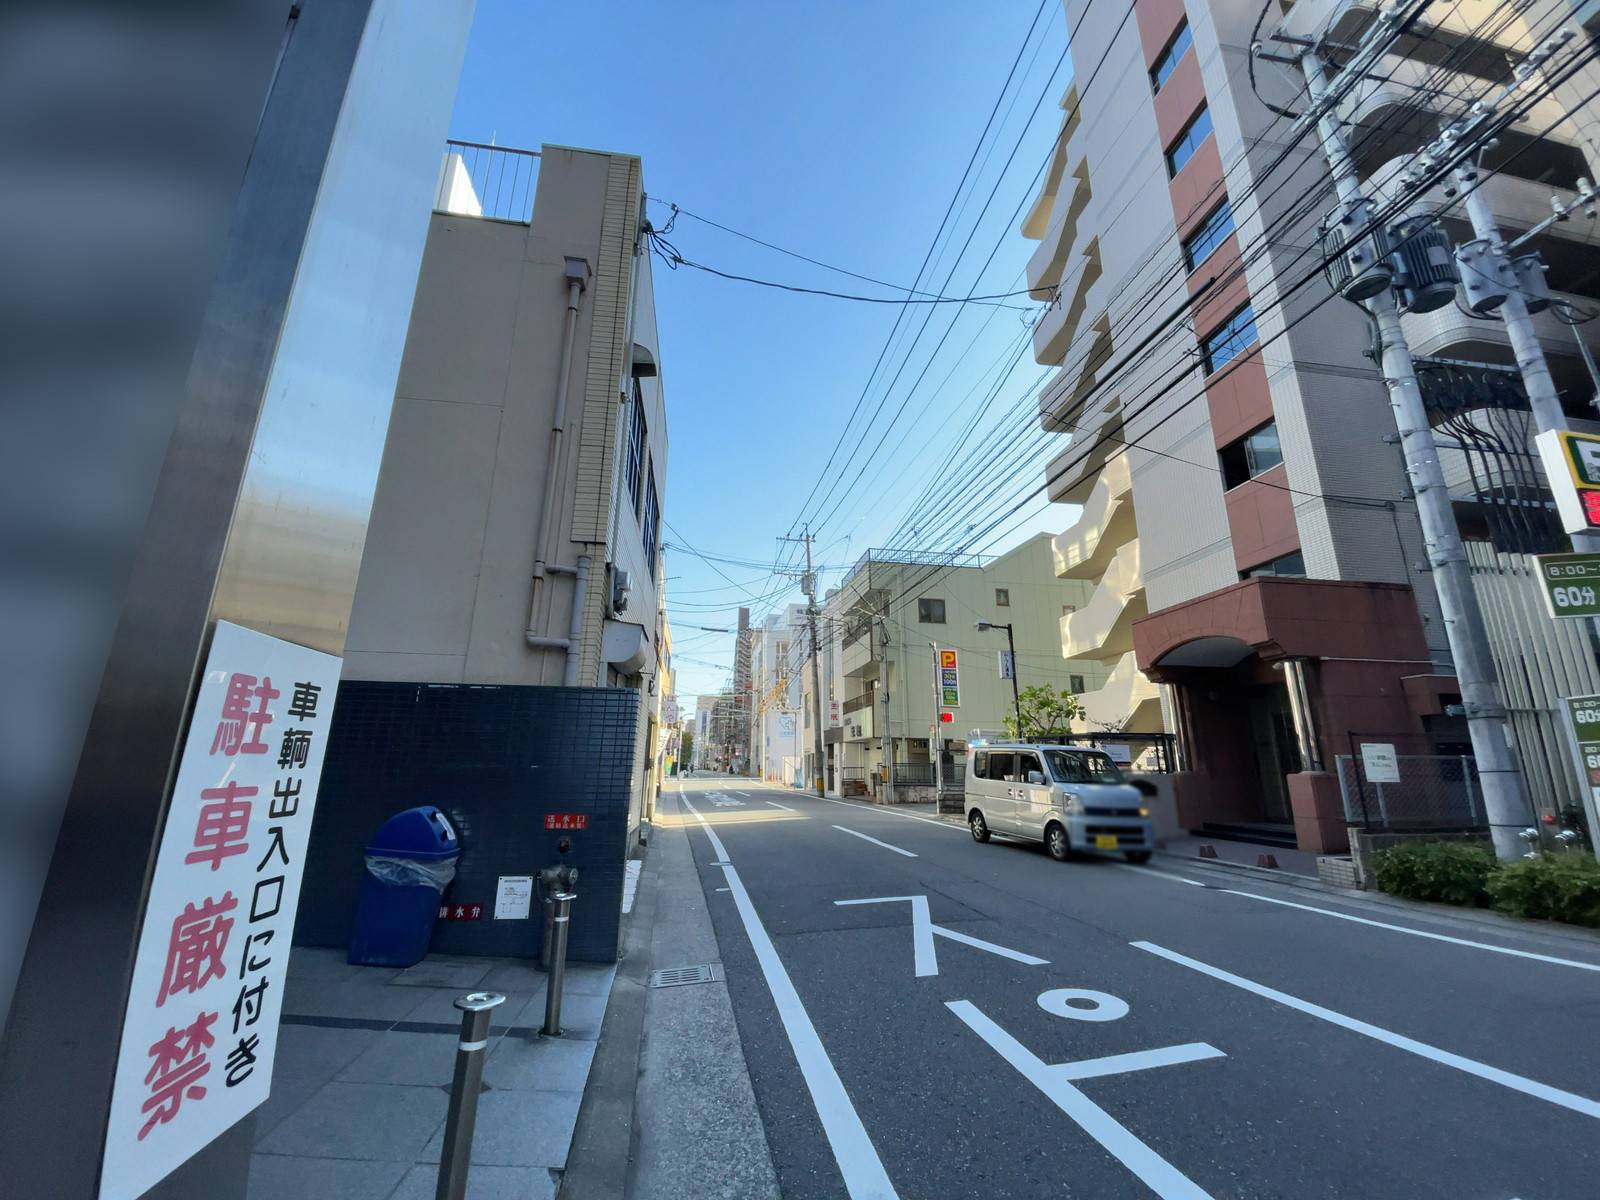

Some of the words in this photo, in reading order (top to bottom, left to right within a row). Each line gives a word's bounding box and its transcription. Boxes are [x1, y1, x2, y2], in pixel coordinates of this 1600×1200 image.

[1553, 586, 1596, 608] 60分
[942, 652, 954, 667] P
[137, 672, 280, 1142] 駐車厳禁
